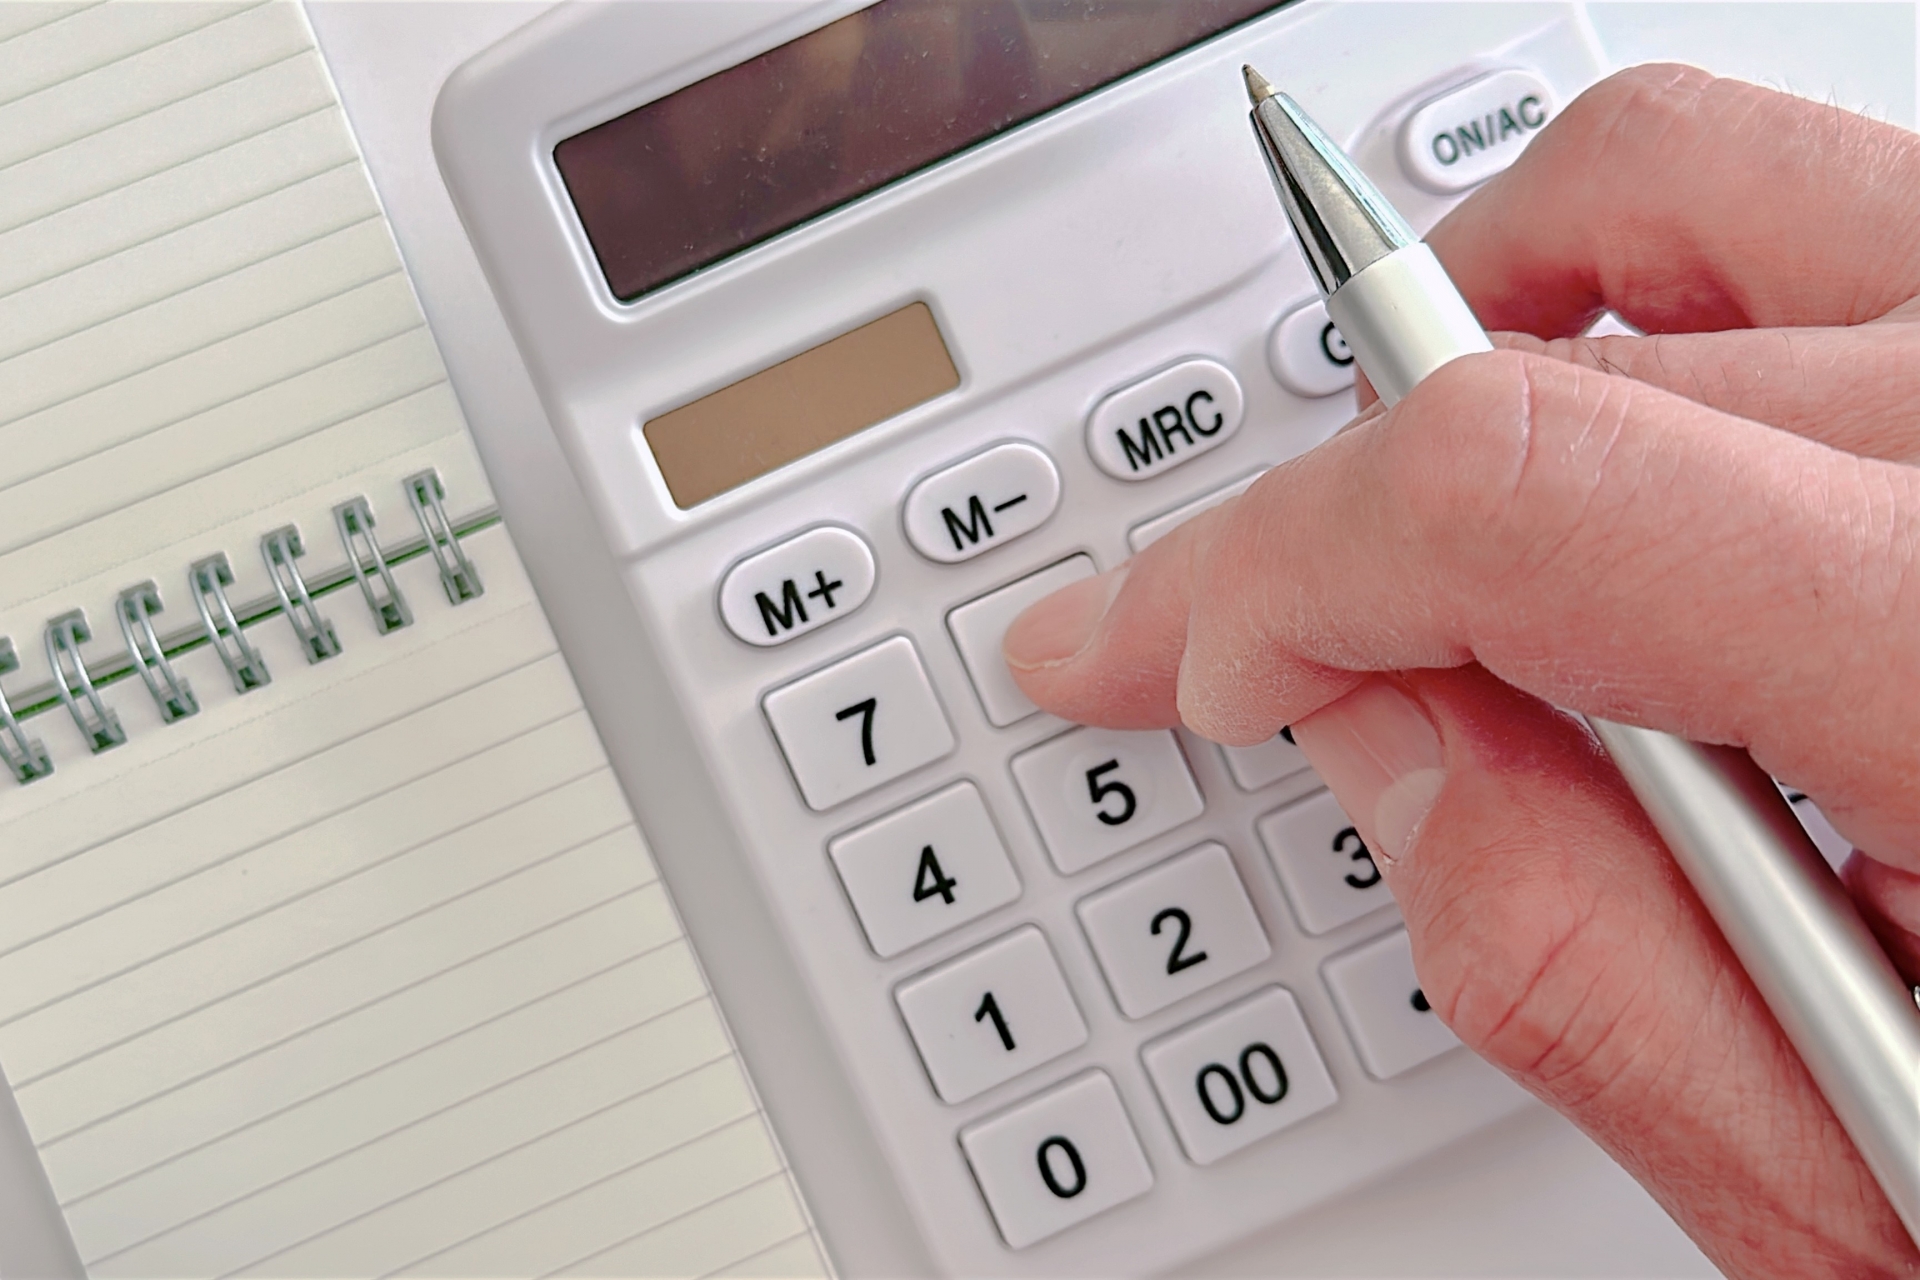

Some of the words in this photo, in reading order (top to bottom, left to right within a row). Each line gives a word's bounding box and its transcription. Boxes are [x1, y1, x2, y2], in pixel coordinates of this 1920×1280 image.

[1431, 94, 1547, 167] ON/AC
[1115, 389, 1224, 472] MRC
[754, 570, 844, 638] M+
[835, 696, 880, 768] 7
[1086, 757, 1139, 828] 5
[911, 843, 958, 906] 4
[1331, 825, 1382, 890] 3
[1149, 906, 1209, 976] 2
[974, 991, 1017, 1053] 1
[1195, 1041, 1290, 1126] 00
[1036, 1135, 1088, 1200] 0
